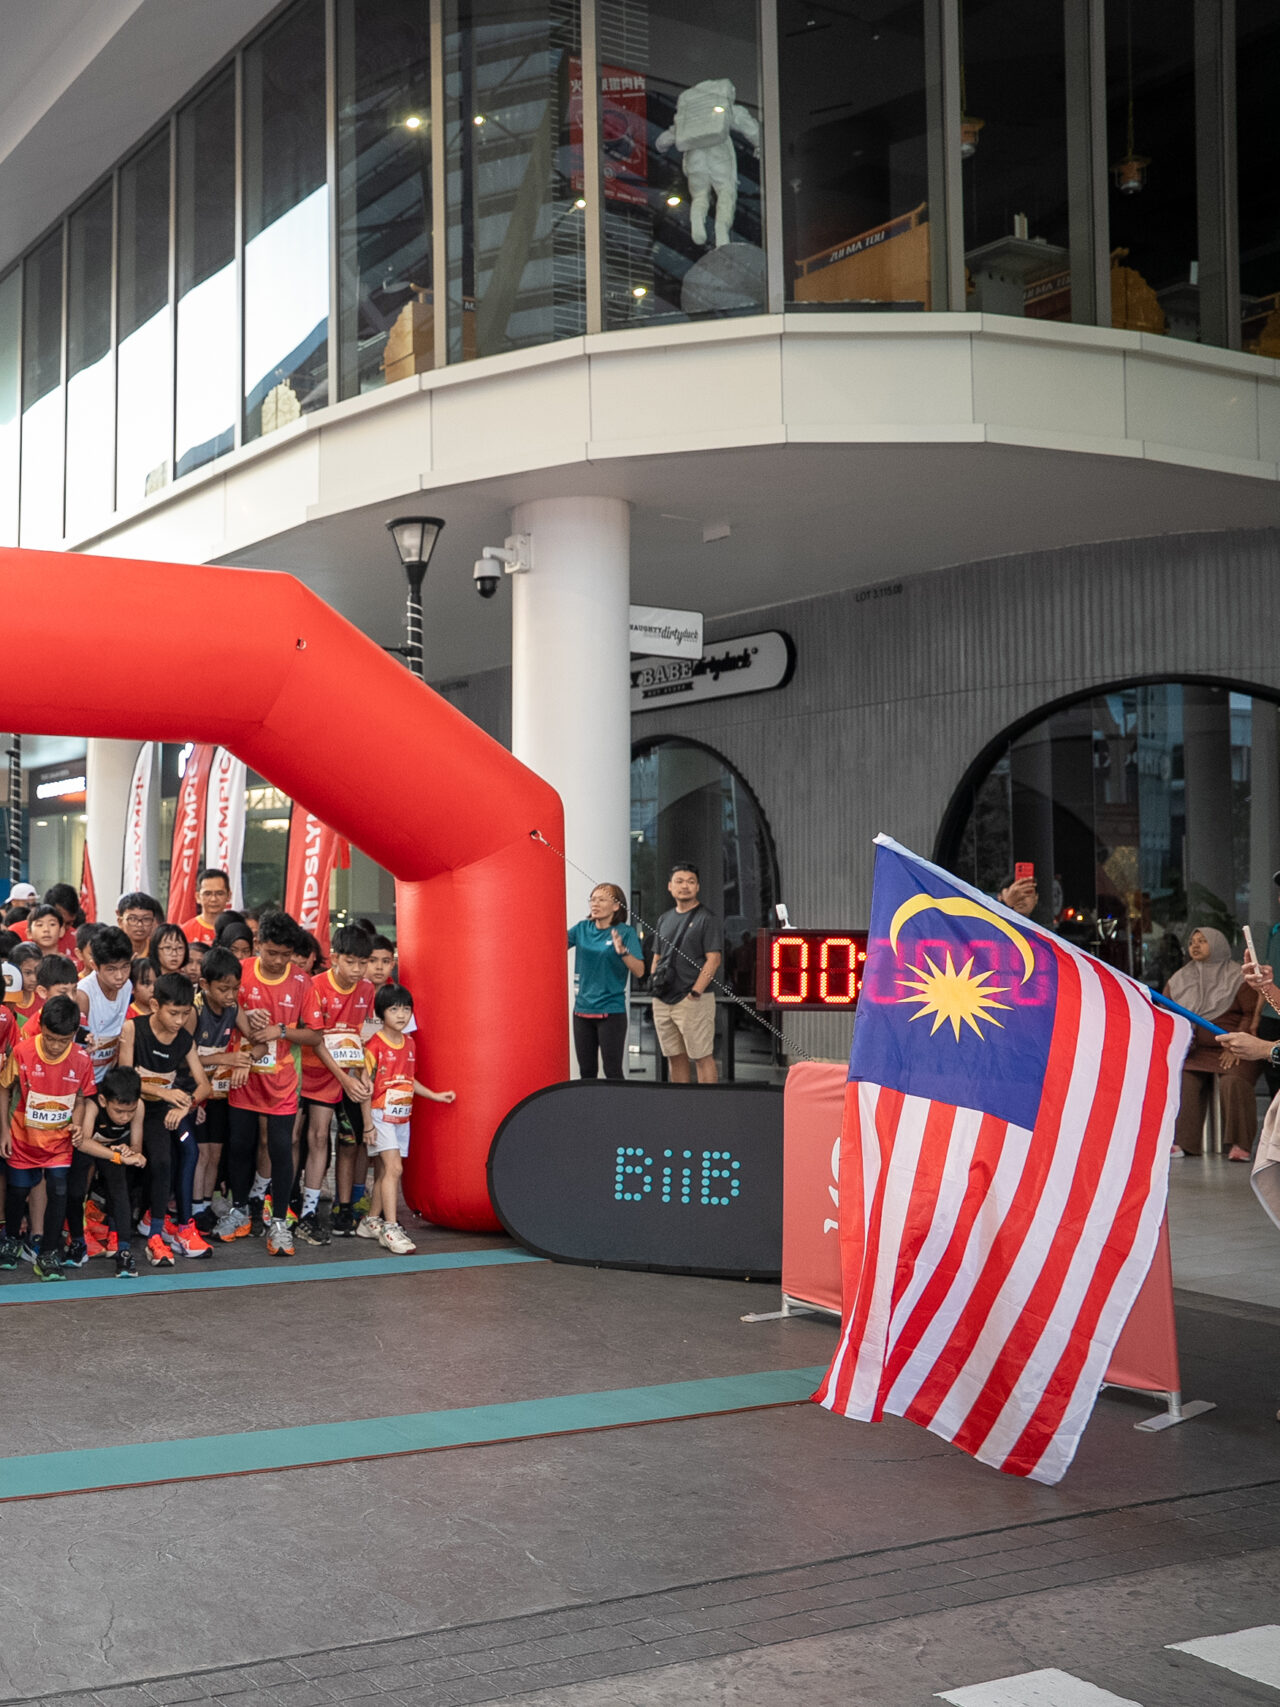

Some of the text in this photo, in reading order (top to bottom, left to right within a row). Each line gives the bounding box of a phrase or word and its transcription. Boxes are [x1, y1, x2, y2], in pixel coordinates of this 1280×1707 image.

[845, 240, 862, 256] MA
[642, 662, 694, 687] BABE
[333, 1050, 348, 1059] BM
[218, 1081, 228, 1089] BF
[32, 1110, 68, 1121] BM 238
[392, 1106, 403, 1115] AF
[614, 1147, 741, 1205] BiiB
